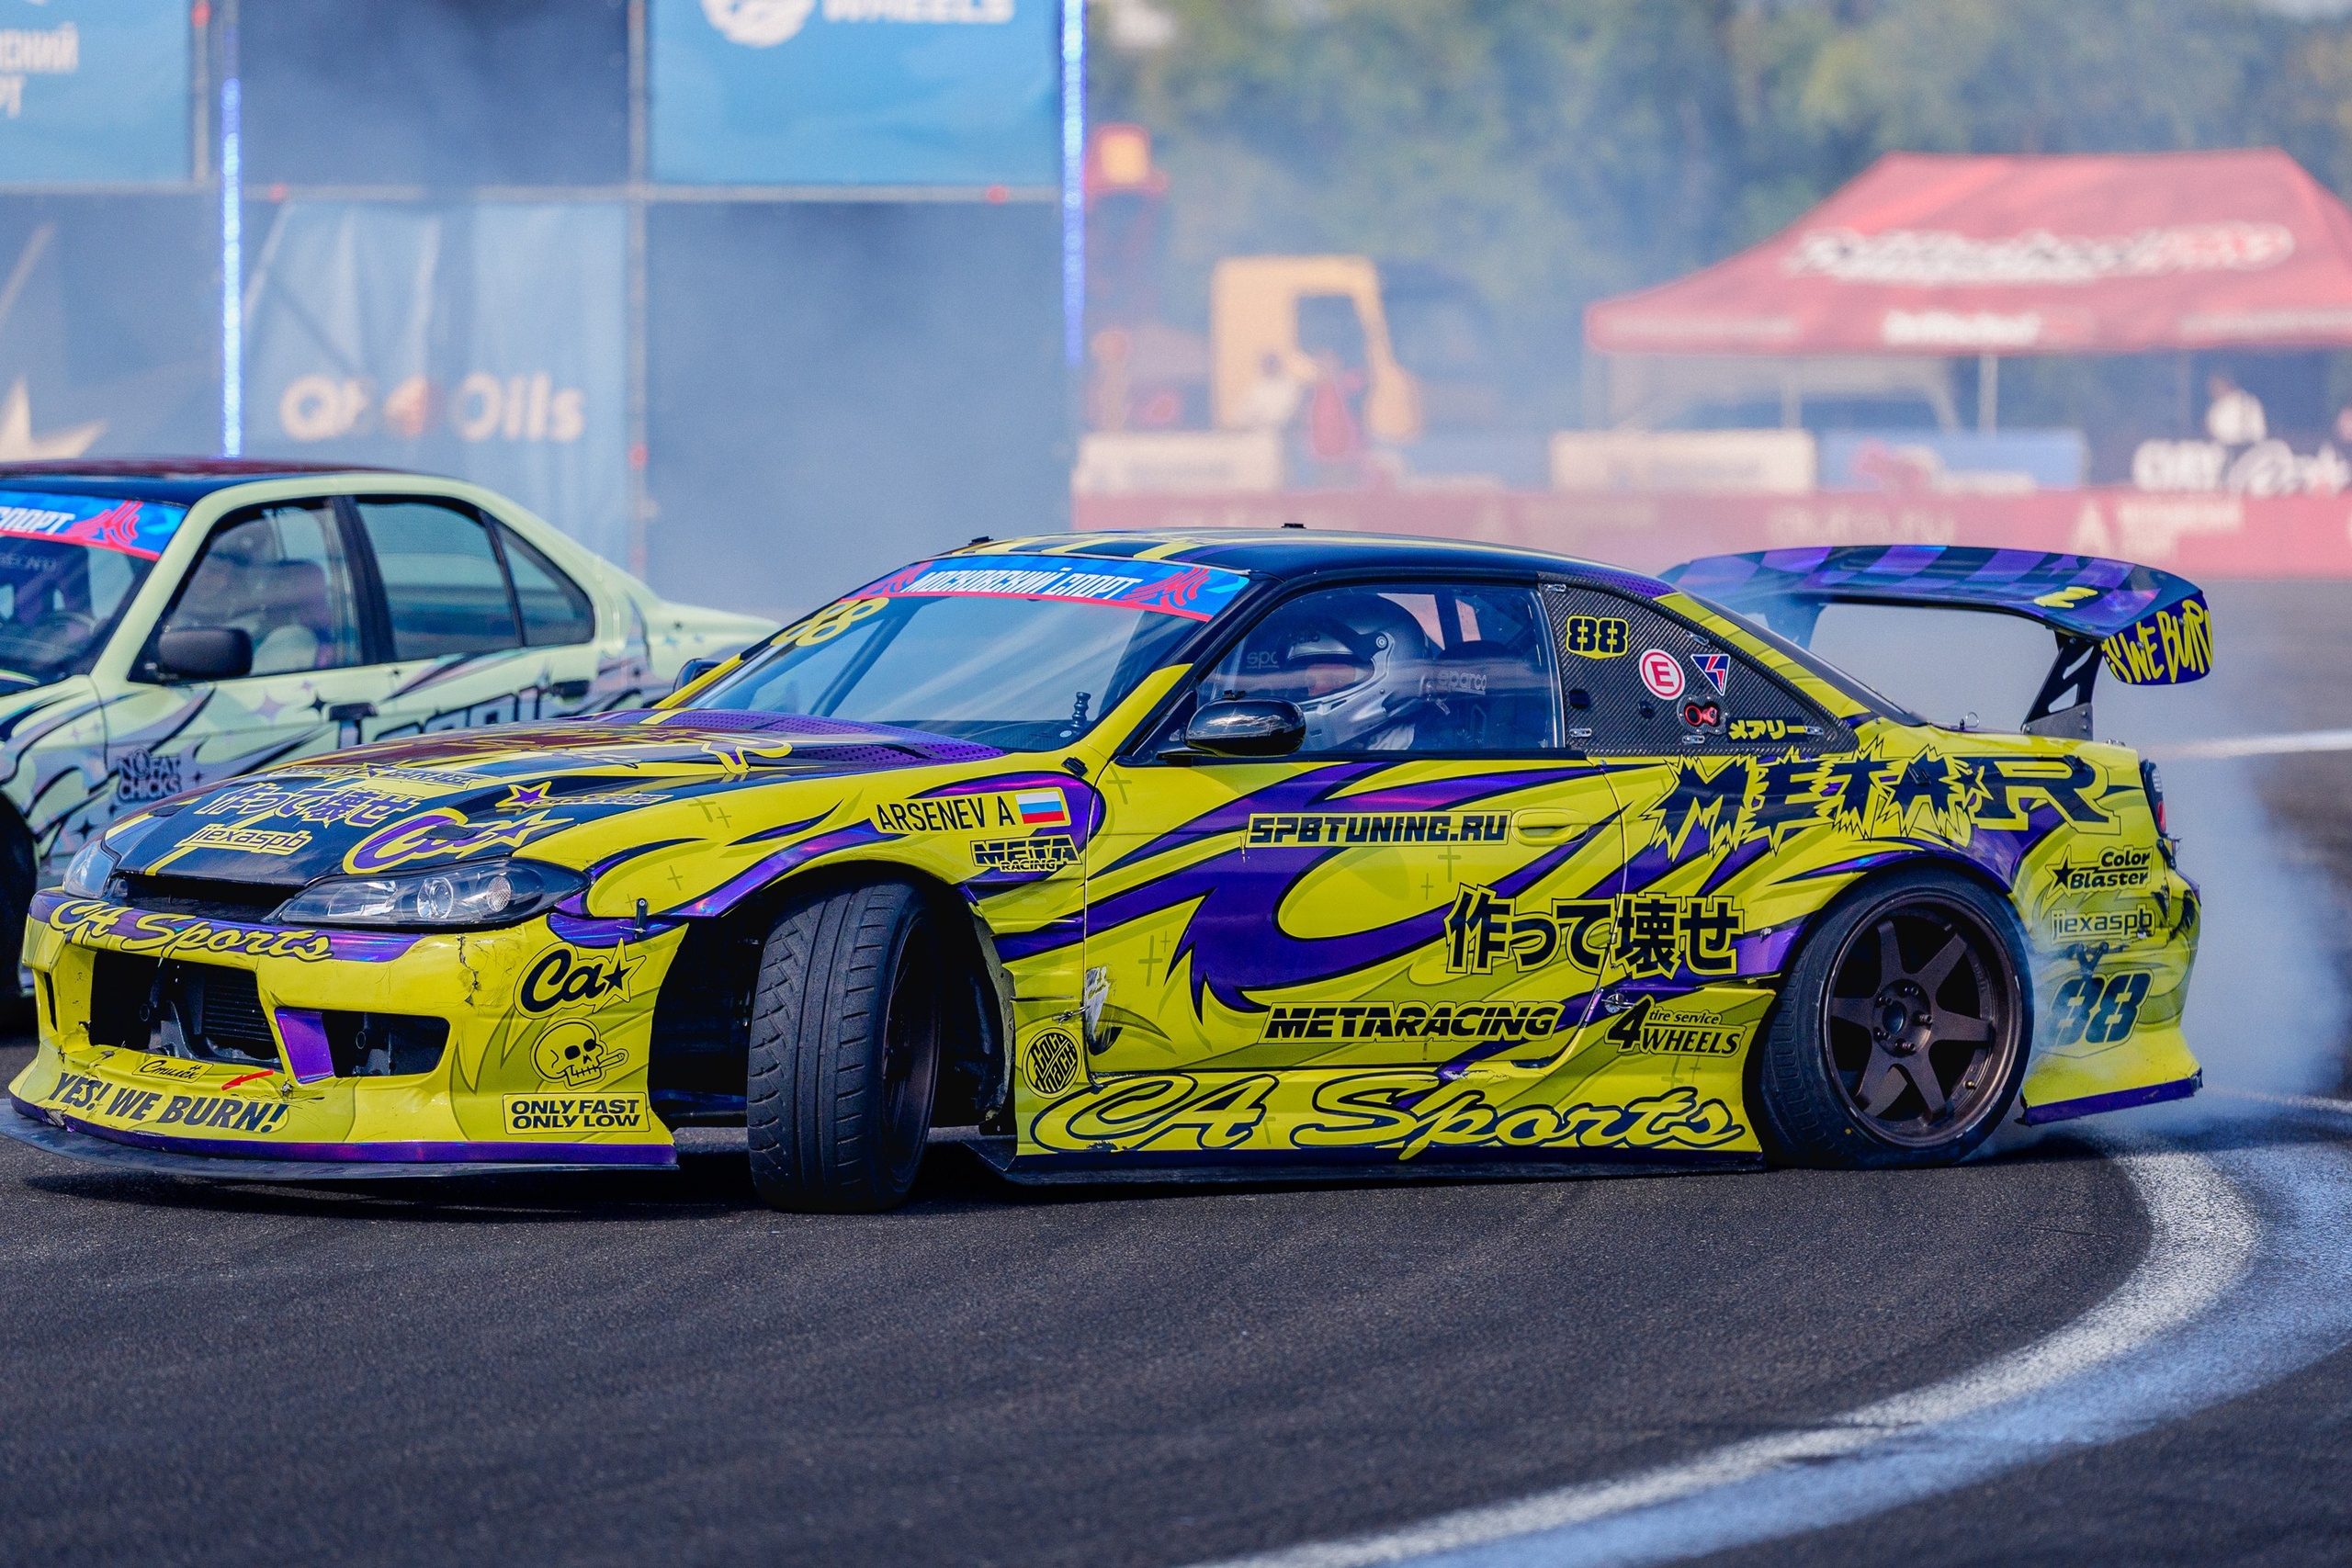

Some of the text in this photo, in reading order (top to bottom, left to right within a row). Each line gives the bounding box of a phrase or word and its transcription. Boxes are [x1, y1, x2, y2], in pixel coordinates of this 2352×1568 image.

[1041, 573, 1143, 600] СПОРТ
[1567, 616, 1628, 654] 88
[1650, 660, 1675, 688] E
[1729, 718, 1807, 741] メアリー
[150, 756, 181, 779] FAT
[876, 795, 1016, 832] ARSENEV A
[1249, 815, 1510, 844] SPBTUNING.RU
[974, 836, 1080, 866] META
[1001, 858, 1057, 872] RACING
[2100, 851, 2151, 867] Color
[2070, 872, 2149, 889] Blaster
[120, 914, 334, 960] Sports
[1447, 887, 1742, 976] 作って壊せ
[1263, 1005, 1560, 1042] METARACING
[1649, 1010, 1670, 1021] tire
[1674, 1011, 1719, 1024] service
[2049, 972, 2153, 1047] 88
[49, 1072, 289, 1134] YES! WE BURN!
[511, 1100, 640, 1115] ONLY FAST
[1291, 1070, 1747, 1161] Sports
[512, 1114, 641, 1129] ONLY LOW
